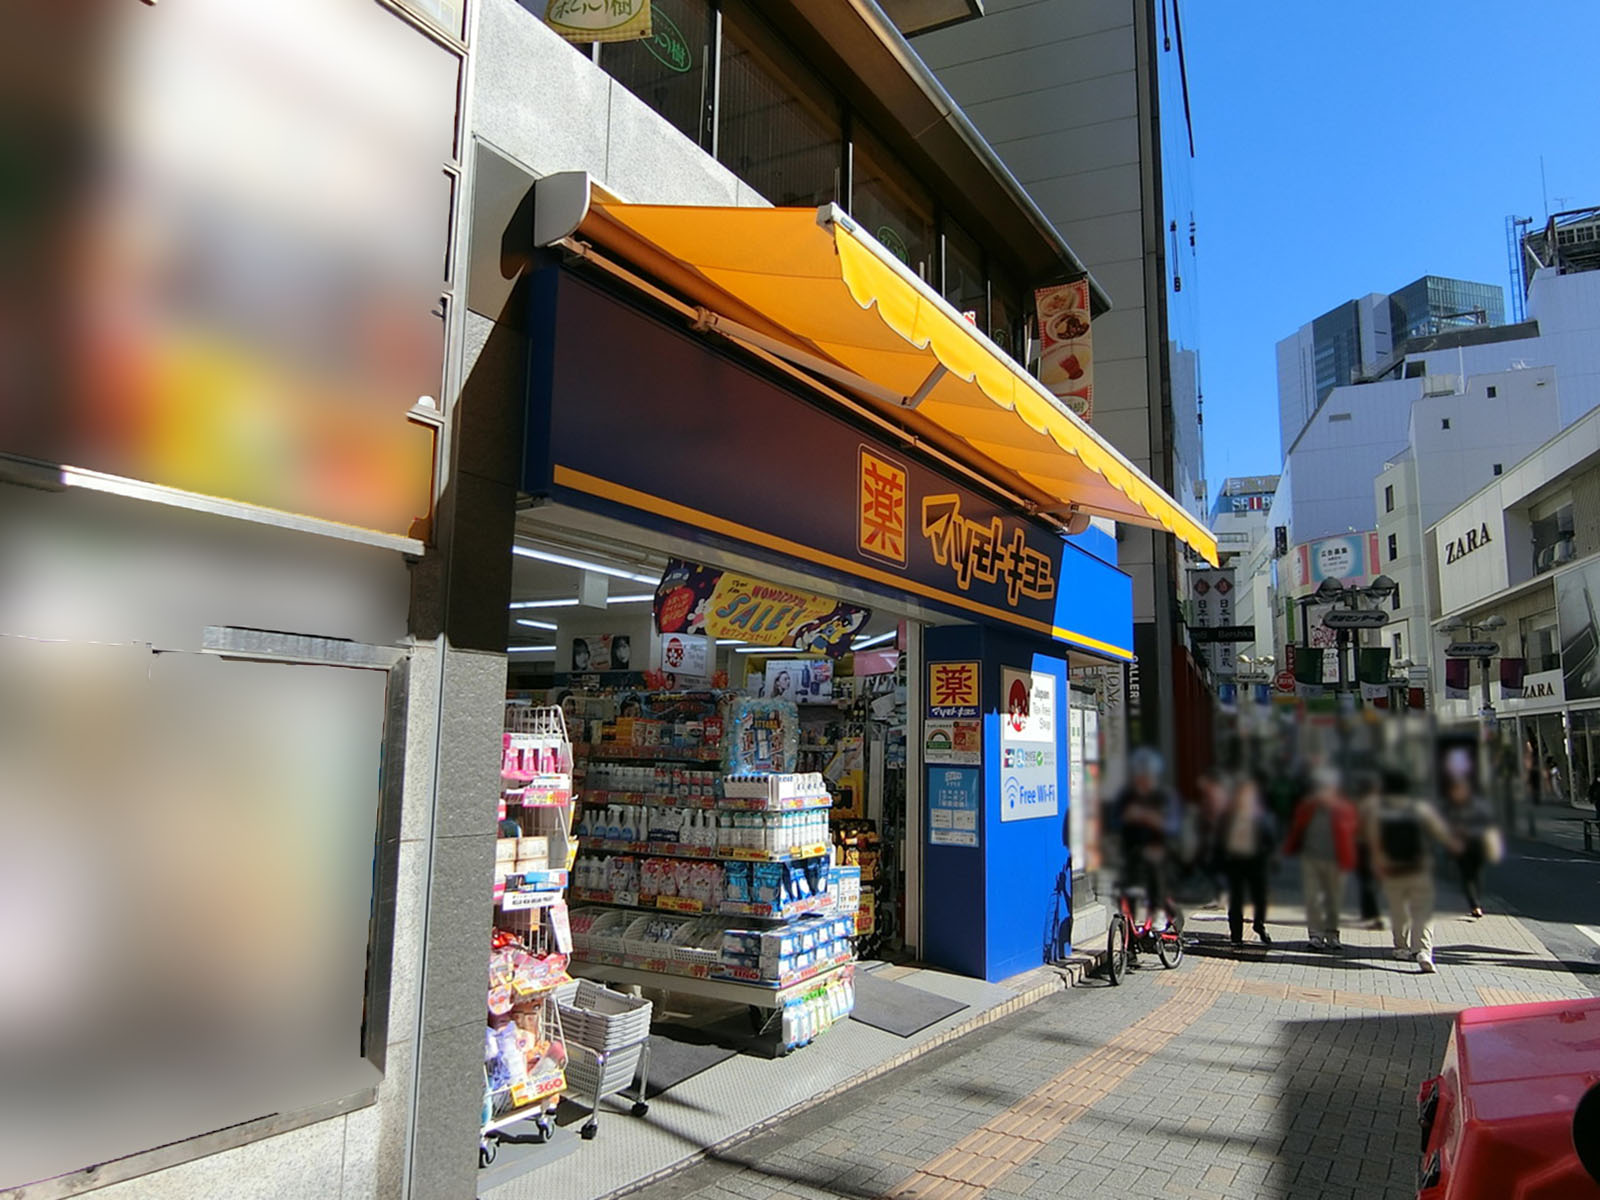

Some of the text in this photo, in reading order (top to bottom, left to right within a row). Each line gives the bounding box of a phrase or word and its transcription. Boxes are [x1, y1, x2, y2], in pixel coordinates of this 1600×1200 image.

[864, 462, 902, 556] 薬
[922, 494, 1055, 606] マツモトキヨシ
[1445, 522, 1493, 565] ZARA
[936, 666, 972, 704] 薬
[1522, 682, 1555, 699] ZARA
[1020, 783, 1055, 804] Free Wi-Fi
[535, 1077, 563, 1094] 360
